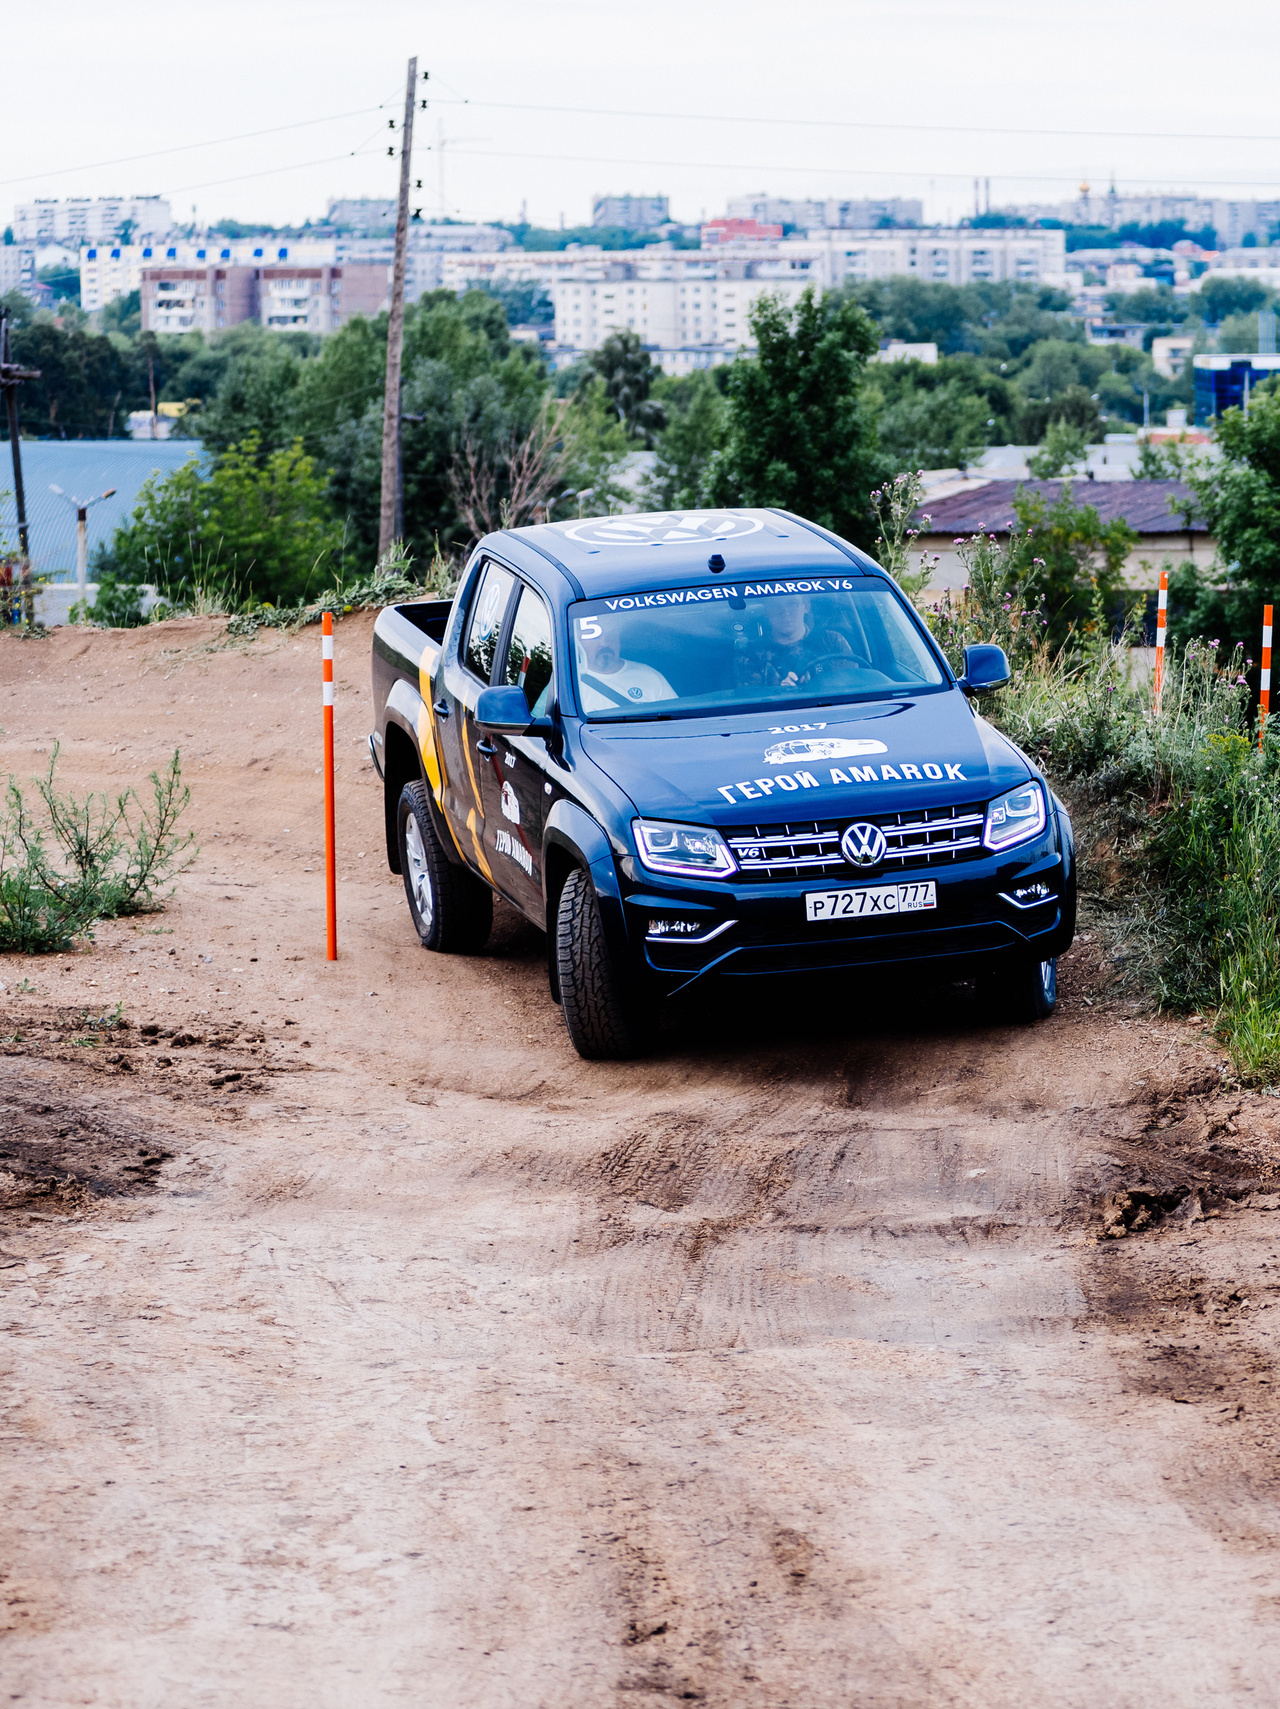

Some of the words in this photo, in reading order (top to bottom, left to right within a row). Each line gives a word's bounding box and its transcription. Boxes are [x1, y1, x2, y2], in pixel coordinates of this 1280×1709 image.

[605, 586, 739, 611] VOLKSWAGEN
[744, 580, 826, 598] AMAROK
[827, 579, 853, 591] V6
[578, 616, 602, 640] 5
[767, 722, 828, 735] 2017
[716, 770, 821, 805] ГЕРОЙ
[829, 763, 968, 786] AMAROK
[737, 847, 760, 859] V6
[899, 884, 930, 903] 777
[907, 901, 923, 909] RUS
